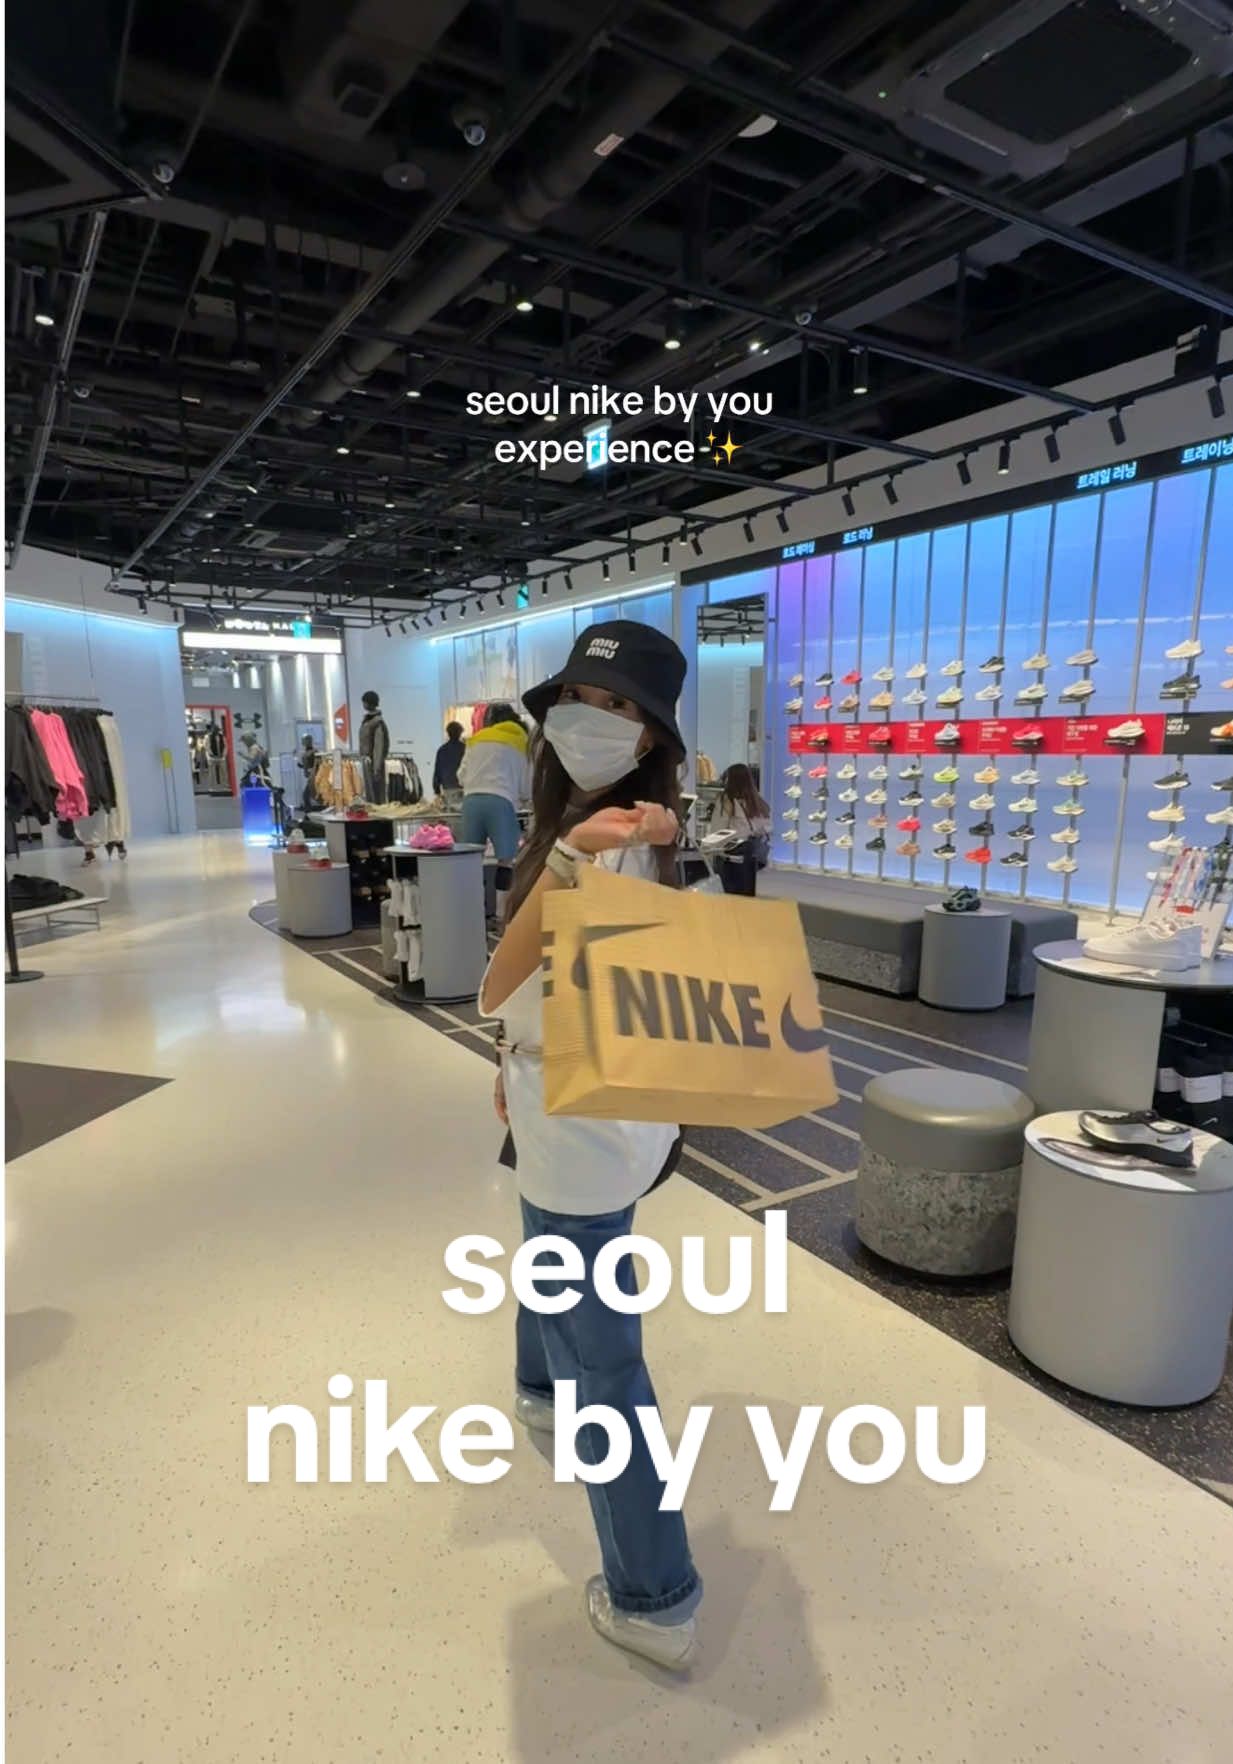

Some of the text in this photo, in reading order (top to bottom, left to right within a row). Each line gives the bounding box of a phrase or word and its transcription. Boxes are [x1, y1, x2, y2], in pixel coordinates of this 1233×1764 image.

[1180, 437, 1233, 464] 트레이닝
[1076, 461, 1138, 489] 트레일 러닝
[610, 965, 771, 1049] NIKE
